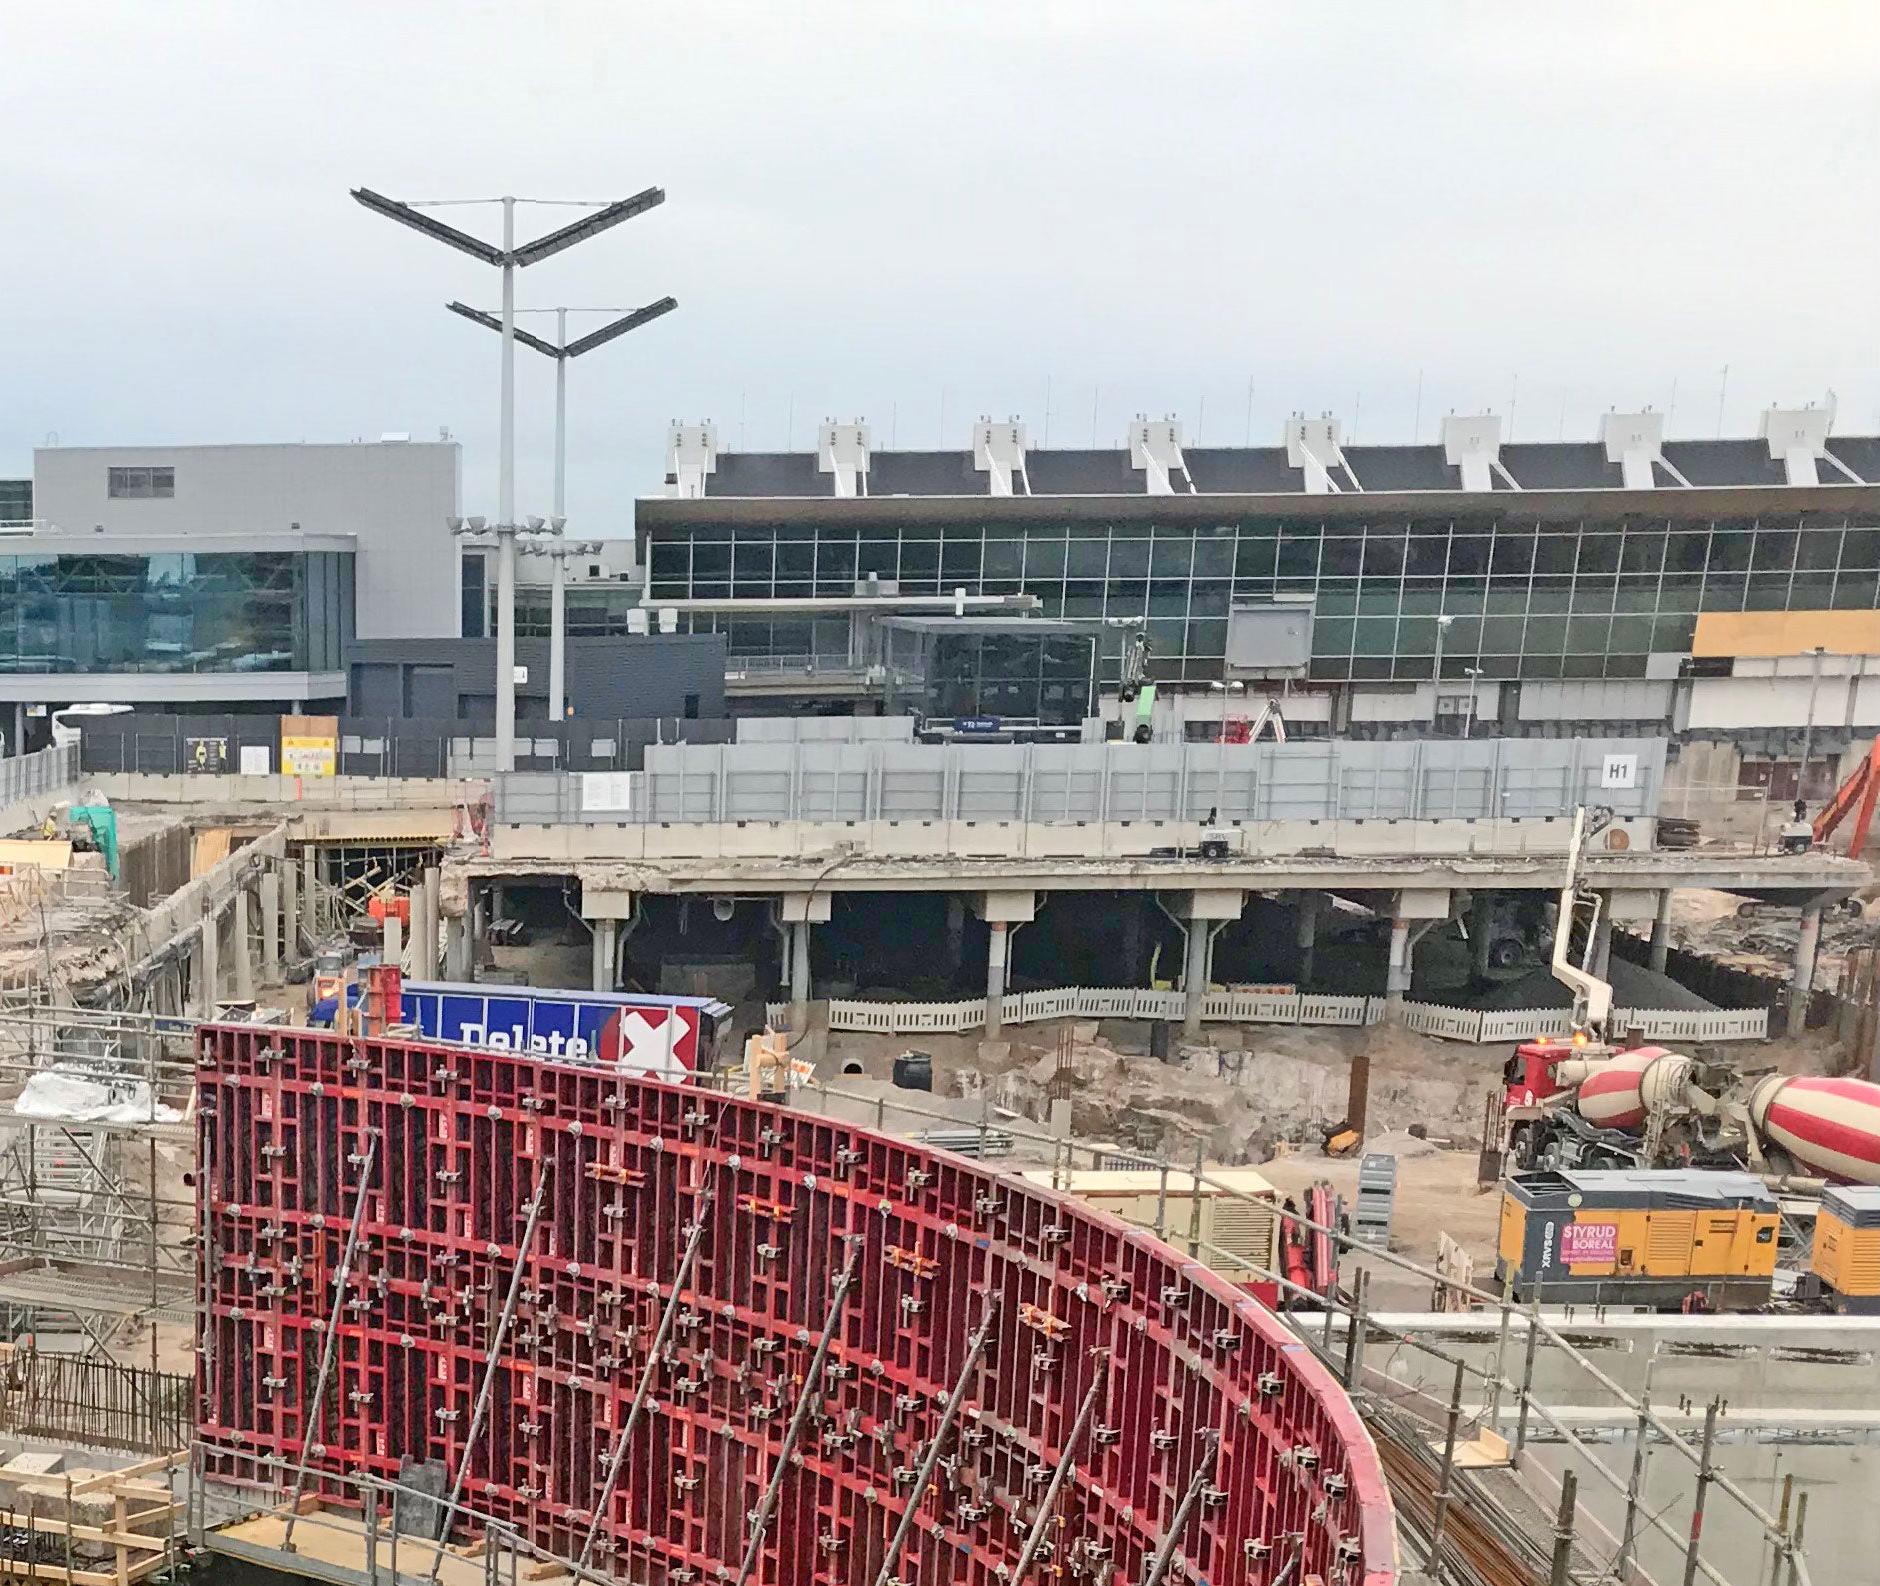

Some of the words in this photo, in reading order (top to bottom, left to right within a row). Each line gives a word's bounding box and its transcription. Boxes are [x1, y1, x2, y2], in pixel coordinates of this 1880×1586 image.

[1609, 764, 1628, 778] H1
[1563, 1225, 1616, 1238] STYRUD
[1572, 1240, 1614, 1249] BOREAL
